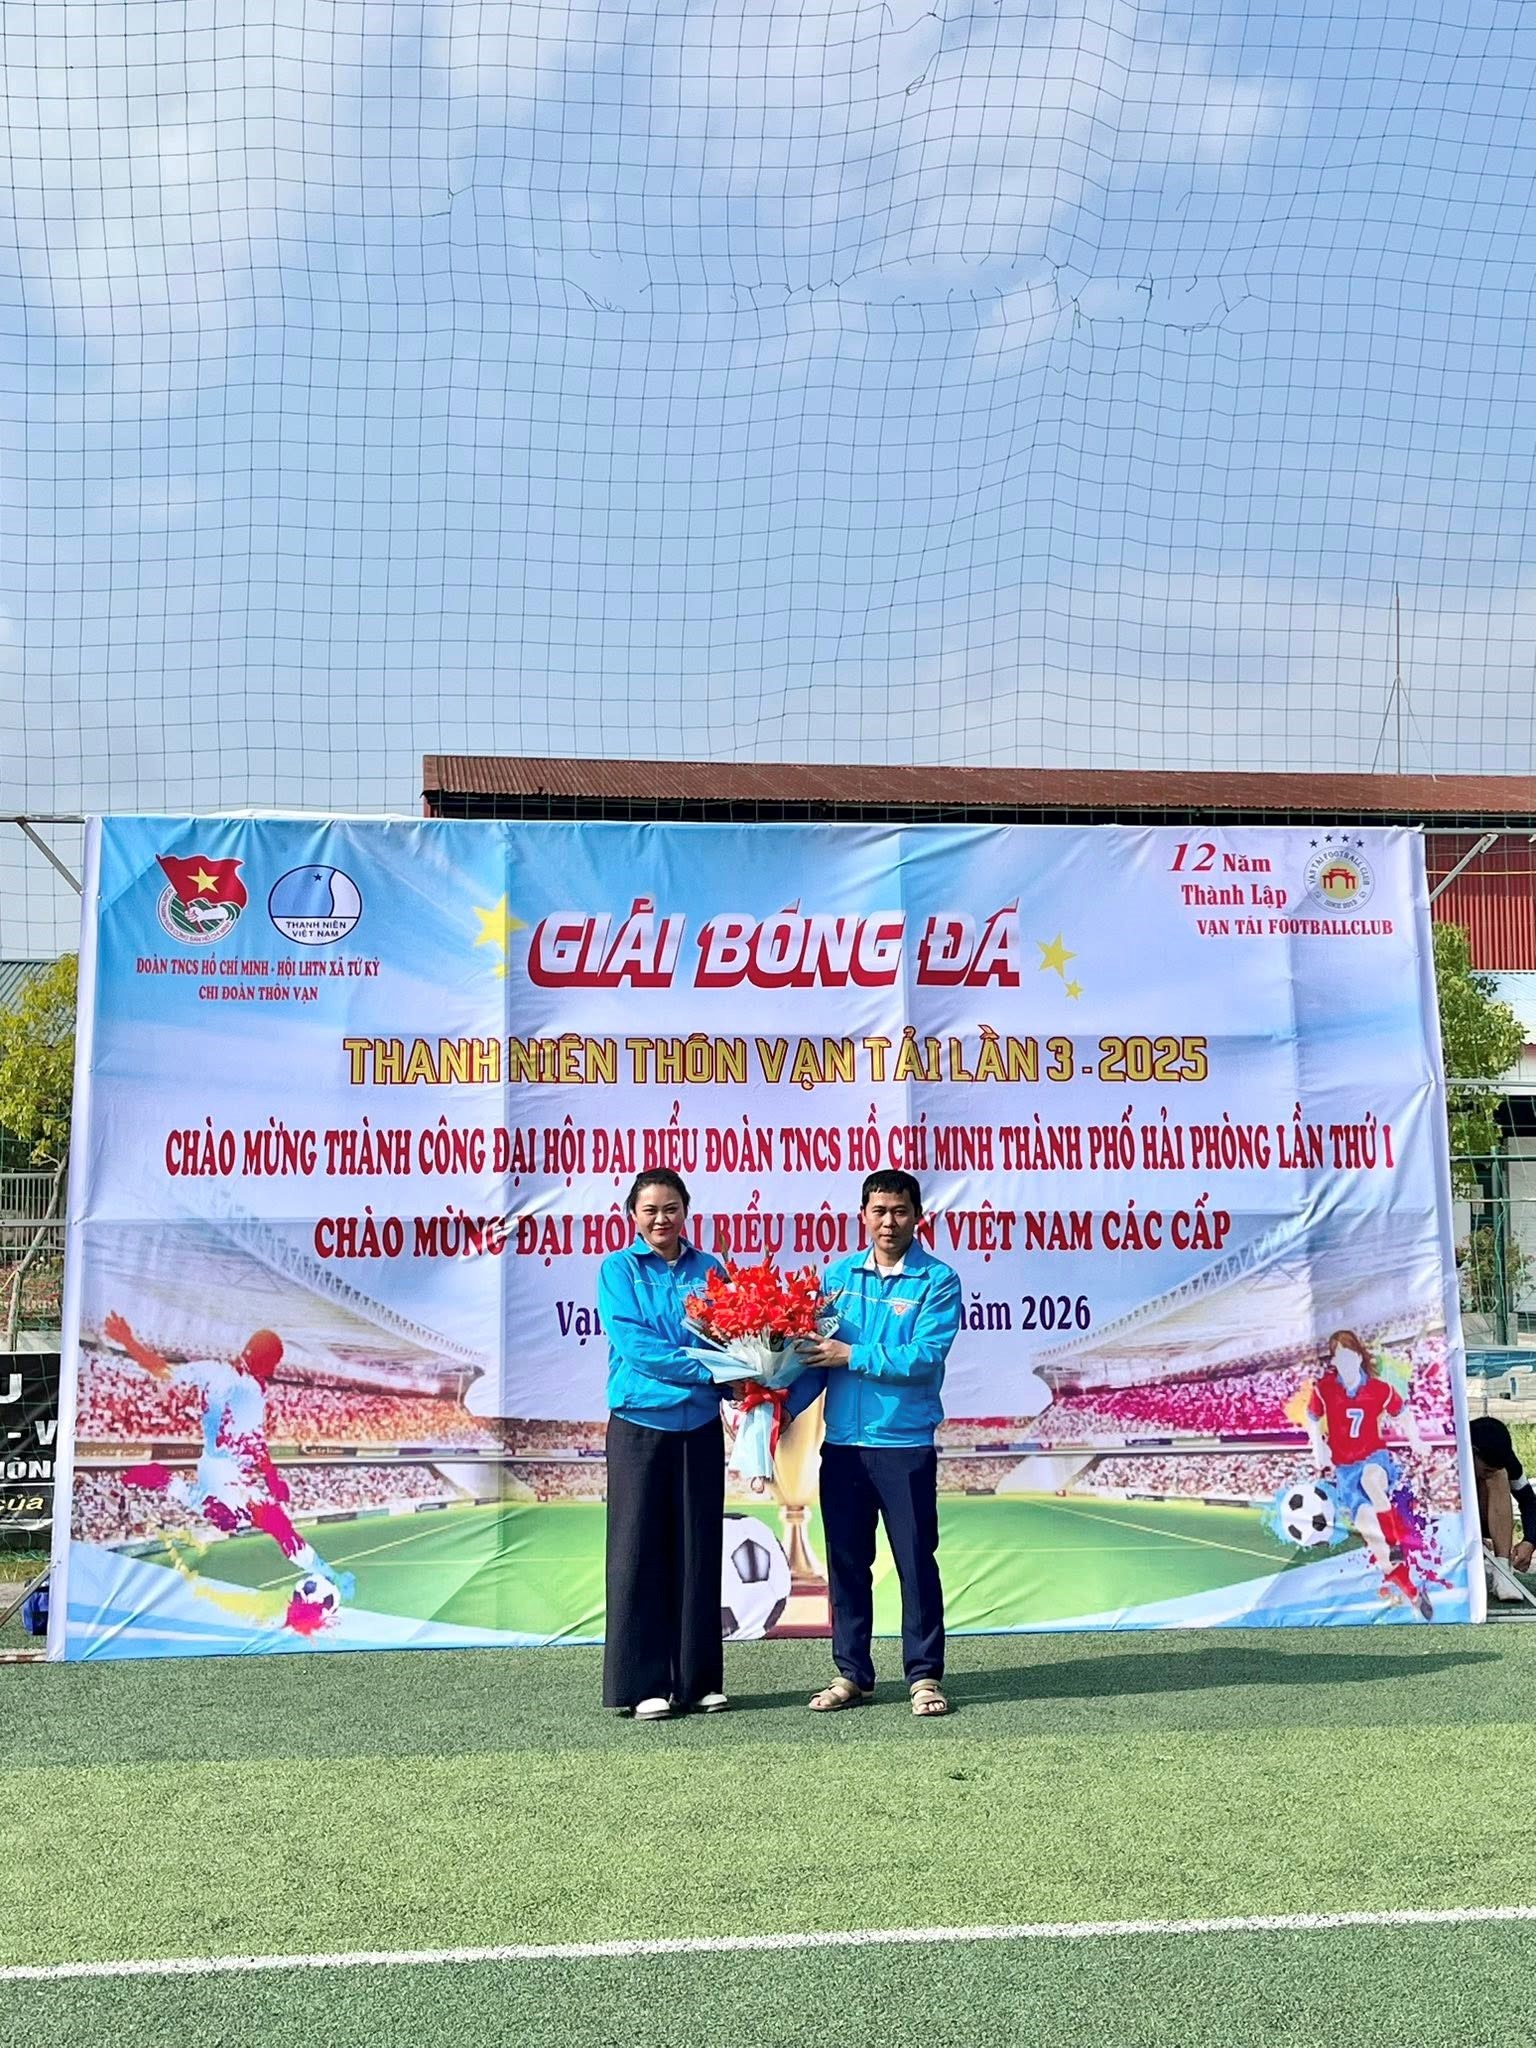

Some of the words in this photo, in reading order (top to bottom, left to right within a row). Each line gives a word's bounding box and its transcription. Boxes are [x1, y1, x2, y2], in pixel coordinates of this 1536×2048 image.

[1168, 843, 1217, 872] 12
[1223, 854, 1271, 872] Năm
[1181, 883, 1244, 906] Thành
[1251, 884, 1287, 909] Lập
[286, 921, 320, 929] THANH
[322, 920, 346, 929] NIÊN
[1196, 919, 1229, 937] VẠN
[1235, 914, 1263, 935] TẢI
[1268, 919, 1393, 936] FOOTBALLCLUB
[528, 898, 685, 988] GIẢI
[695, 898, 907, 988] BÓNG
[916, 898, 1020, 988] ĐÁ
[171, 959, 199, 975] TNCS
[220, 955, 238, 975] CHÍ
[241, 960, 269, 976] MINH
[277, 956, 296, 980] HỘI
[299, 961, 327, 976] LHTN
[329, 956, 345, 976] XÃ
[347, 956, 363, 976] TỨ
[199, 985, 219, 1000] CHI
[222, 982, 255, 1001] ĐOÀN
[258, 983, 290, 1001] THÔN
[293, 986, 318, 1004] VẠN
[343, 1037, 500, 1085] THANH
[509, 1033, 617, 1084] NIÊN
[625, 1033, 747, 1084] THÔN
[756, 1036, 855, 1091] VẠN
[862, 1025, 943, 1081] TẢI
[950, 1024, 1040, 1082] LẦN
[1046, 1037, 1074, 1082] 3
[1099, 1036, 1208, 1082] 2025
[165, 1116, 236, 1176] CHÀO
[242, 1116, 317, 1176] MỪNG
[324, 1116, 411, 1175] THÀNH
[418, 1114, 486, 1174] CÔNG
[492, 1127, 536, 1187] ĐẠI
[543, 1114, 585, 1187] HỘI
[592, 1127, 636, 1187] ĐẠI
[643, 1099, 699, 1173] BIỂU
[705, 1114, 773, 1172] ĐOÀN
[780, 1127, 841, 1172] TNCS
[848, 1103, 881, 1172] HỒ
[887, 1112, 931, 1171] CHÍ
[934, 1125, 994, 1171] MINH
[999, 1112, 1083, 1171] THÀNH
[1088, 1104, 1136, 1170] PHỐ
[1141, 1106, 1186, 1170] HẢI
[1189, 1112, 1271, 1169] PHÒNG
[1276, 1102, 1323, 1169] LẦN
[1329, 1111, 1378, 1168] THỨ
[1383, 1124, 1394, 1168] I
[314, 1205, 404, 1258] CHÀO
[413, 1205, 508, 1257] MỪNG
[516, 1214, 573, 1267] ĐẠI
[712, 1189, 785, 1253] BIỂU
[793, 1200, 848, 1264] HỘI
[945, 1200, 1016, 1263] VIỆT
[1024, 1210, 1093, 1251] NAM
[1102, 1199, 1162, 1250] CÁC
[1171, 1192, 1231, 1250] CẤP
[1022, 1295, 1091, 1331] 2026
[1346, 1408, 1365, 1438] 7
